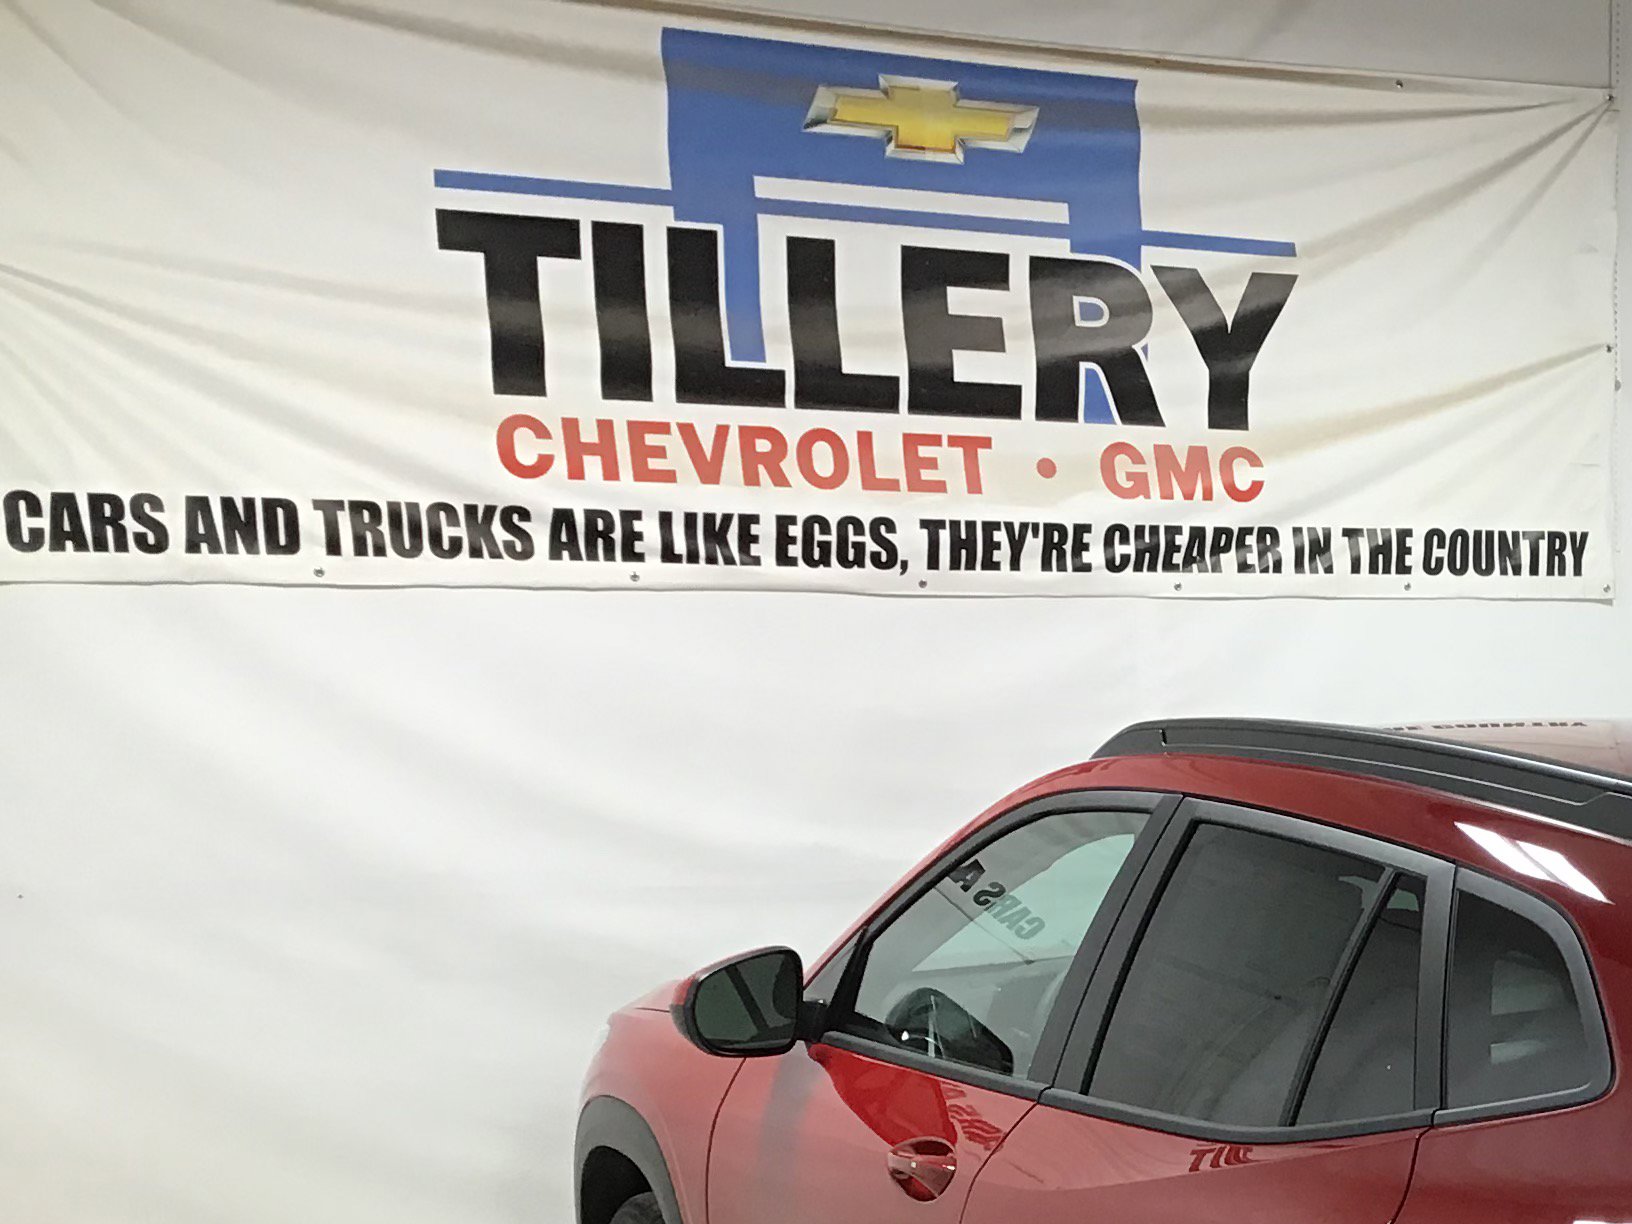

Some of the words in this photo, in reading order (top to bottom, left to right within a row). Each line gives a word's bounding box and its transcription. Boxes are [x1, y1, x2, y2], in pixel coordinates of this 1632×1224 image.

[435, 208, 1298, 431] TILLERY
[496, 414, 992, 497] CHEVROLET
[1100, 441, 1265, 503] GMC
[4, 489, 169, 554] CARS
[184, 496, 301, 556] AND
[312, 498, 535, 561] TRUCKS
[548, 507, 646, 563] ARE
[658, 511, 761, 567] LIKE
[775, 514, 909, 577] EGGS,
[919, 518, 1093, 573] THEY'RE
[1104, 523, 1283, 576] CHEAPER
[1293, 526, 1334, 576] IN
[1341, 528, 1413, 576] THE
[1422, 529, 1589, 577] COUNTRY
